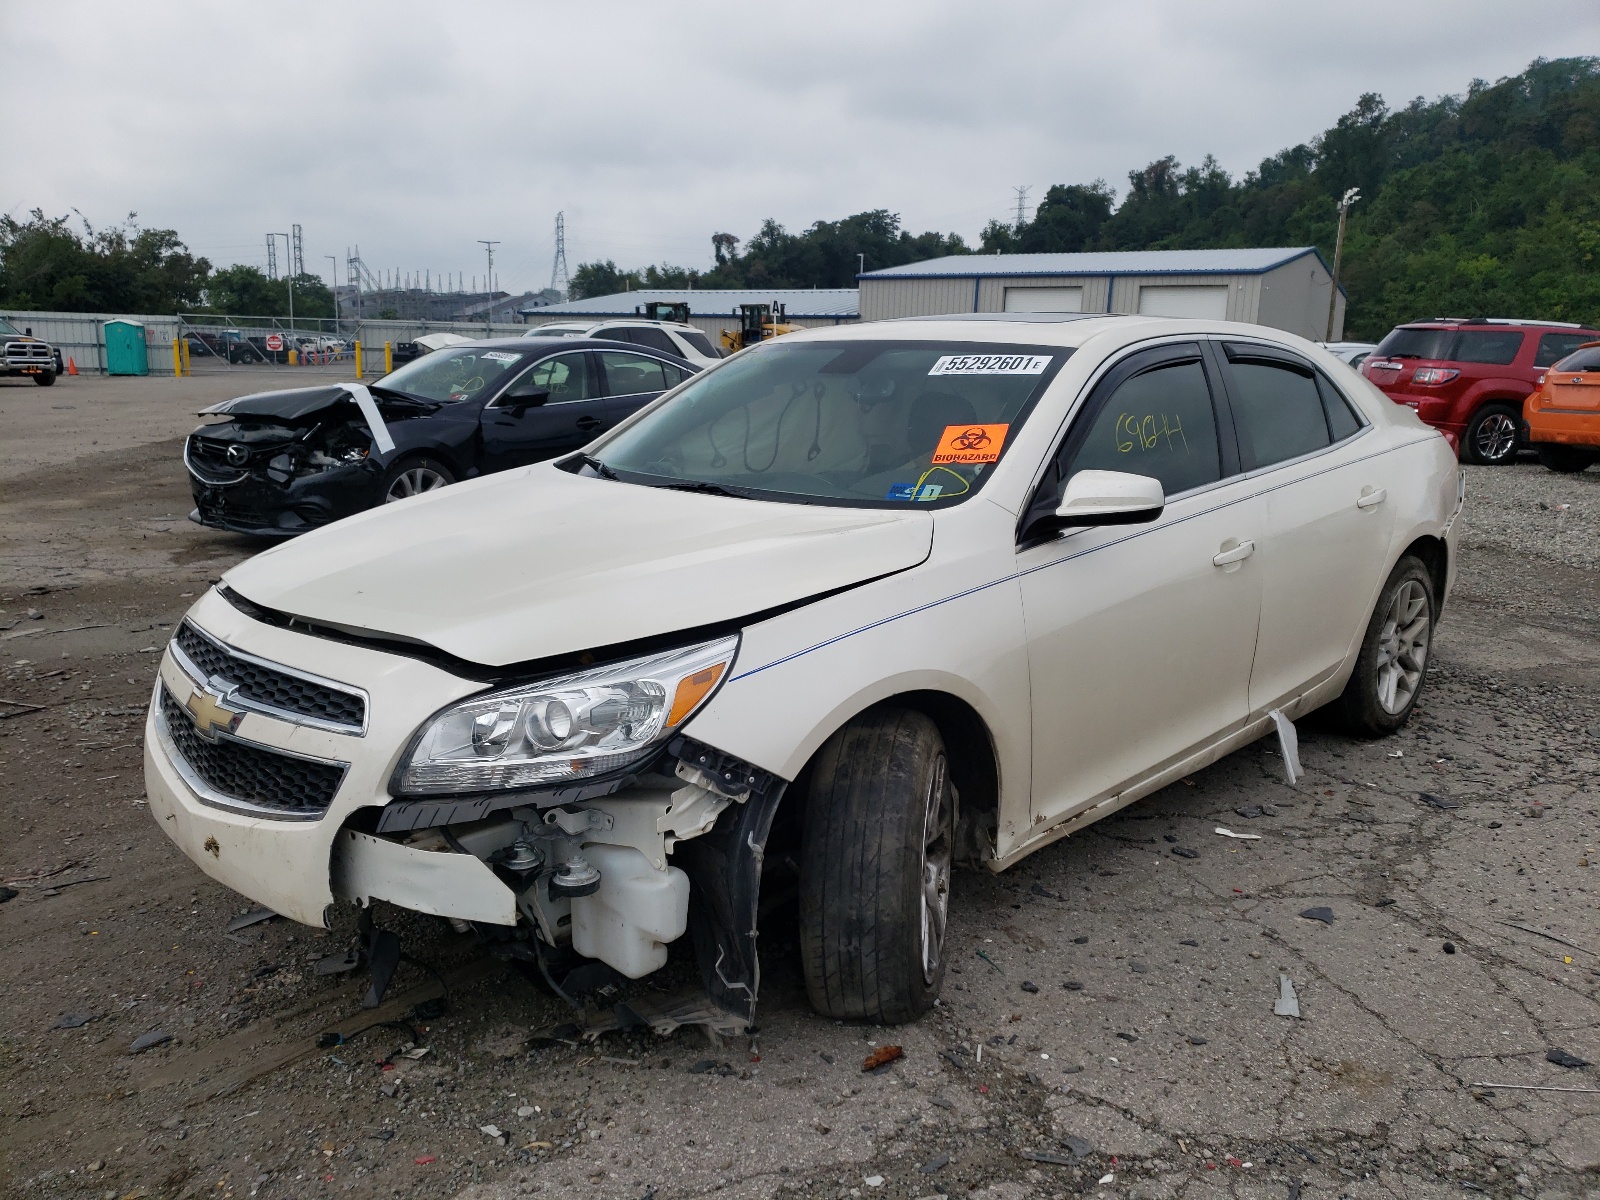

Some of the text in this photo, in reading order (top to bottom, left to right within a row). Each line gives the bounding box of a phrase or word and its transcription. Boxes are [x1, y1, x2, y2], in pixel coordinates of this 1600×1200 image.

[772, 300, 780, 314] A
[945, 356, 1035, 371] 55292601
[934, 453, 997, 462] BIOHAZARD
